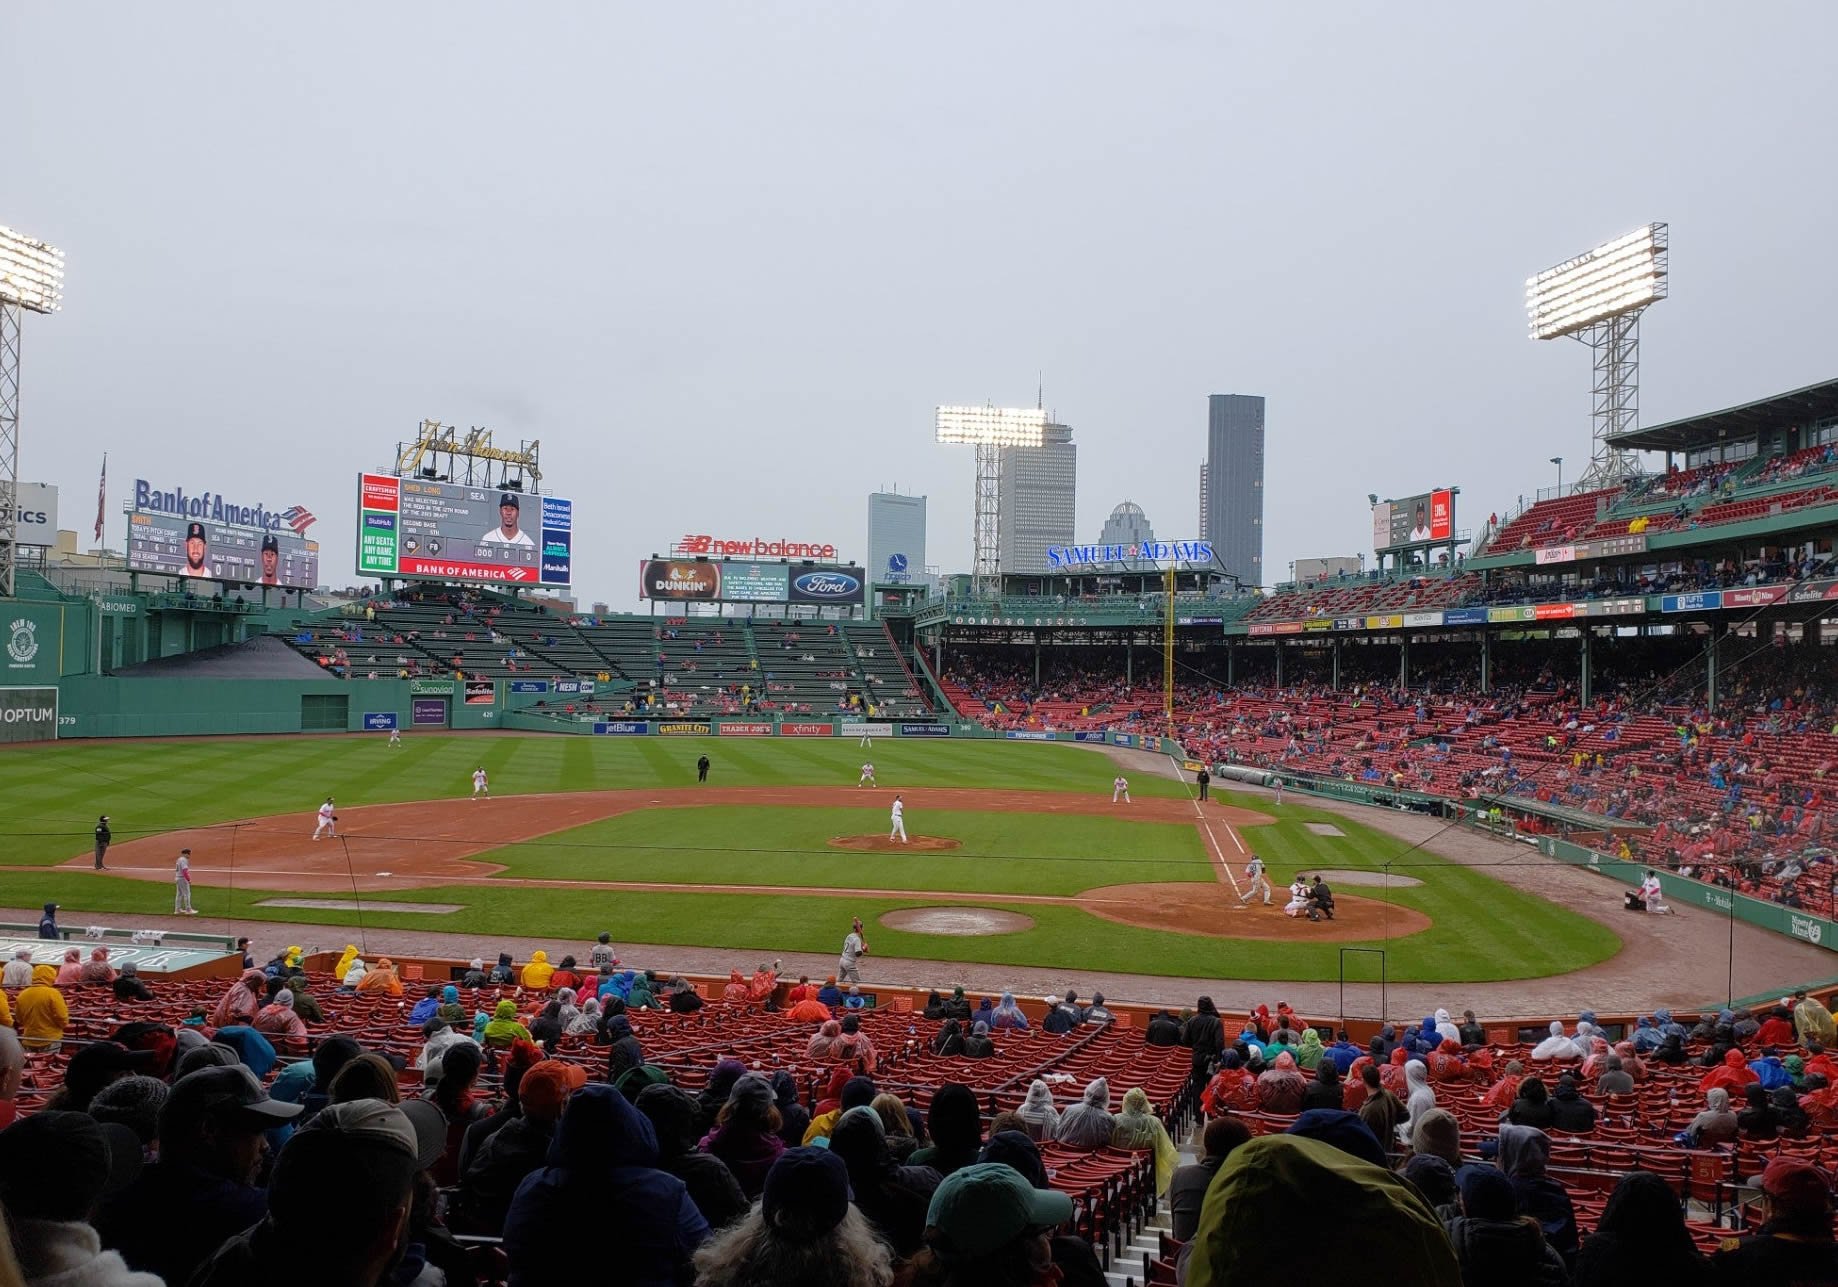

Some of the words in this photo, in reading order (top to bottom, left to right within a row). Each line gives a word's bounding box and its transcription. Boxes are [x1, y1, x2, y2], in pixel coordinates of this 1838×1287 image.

[365, 486, 396, 494] CRAFTSMAN
[470, 492, 485, 500] SEA
[135, 479, 187, 514] Bank
[191, 492, 211, 518] of
[212, 494, 280, 530] America
[543, 502, 556, 510] Beth
[364, 535, 375, 544] ANY
[169, 546, 177, 554] 67
[365, 545, 375, 554] ANY
[713, 540, 752, 555] new
[755, 536, 834, 558] balance
[212, 553, 225, 561] BALLS
[475, 548, 493, 557] .000
[504, 551, 509, 559] 0
[527, 553, 531, 561] 0
[1047, 544, 1128, 568] SAMUEL
[1137, 539, 1213, 563] ADAMS
[366, 555, 377, 565] ANY
[378, 556, 392, 566] TIME
[215, 564, 221, 576] 0
[416, 564, 445, 575] BANK
[447, 566, 460, 576] OF
[461, 567, 506, 579] AMERICA
[655, 581, 707, 591] DUNKIN'
[806, 576, 847, 593] Ford
[1795, 590, 1823, 600] Safelite
[101, 602, 137, 613] ABIOMED
[559, 683, 577, 692] NESN
[4, 708, 53, 723] OPTUM
[59, 717, 76, 725] 379
[369, 717, 391, 725] IRVING
[606, 723, 636, 734] jetBlue
[660, 724, 693, 733] GRANITE
[693, 724, 710, 734] CITY
[751, 725, 771, 733] JOE'S
[793, 724, 820, 735] xfinity
[1700, 1168, 1714, 1177] 51
